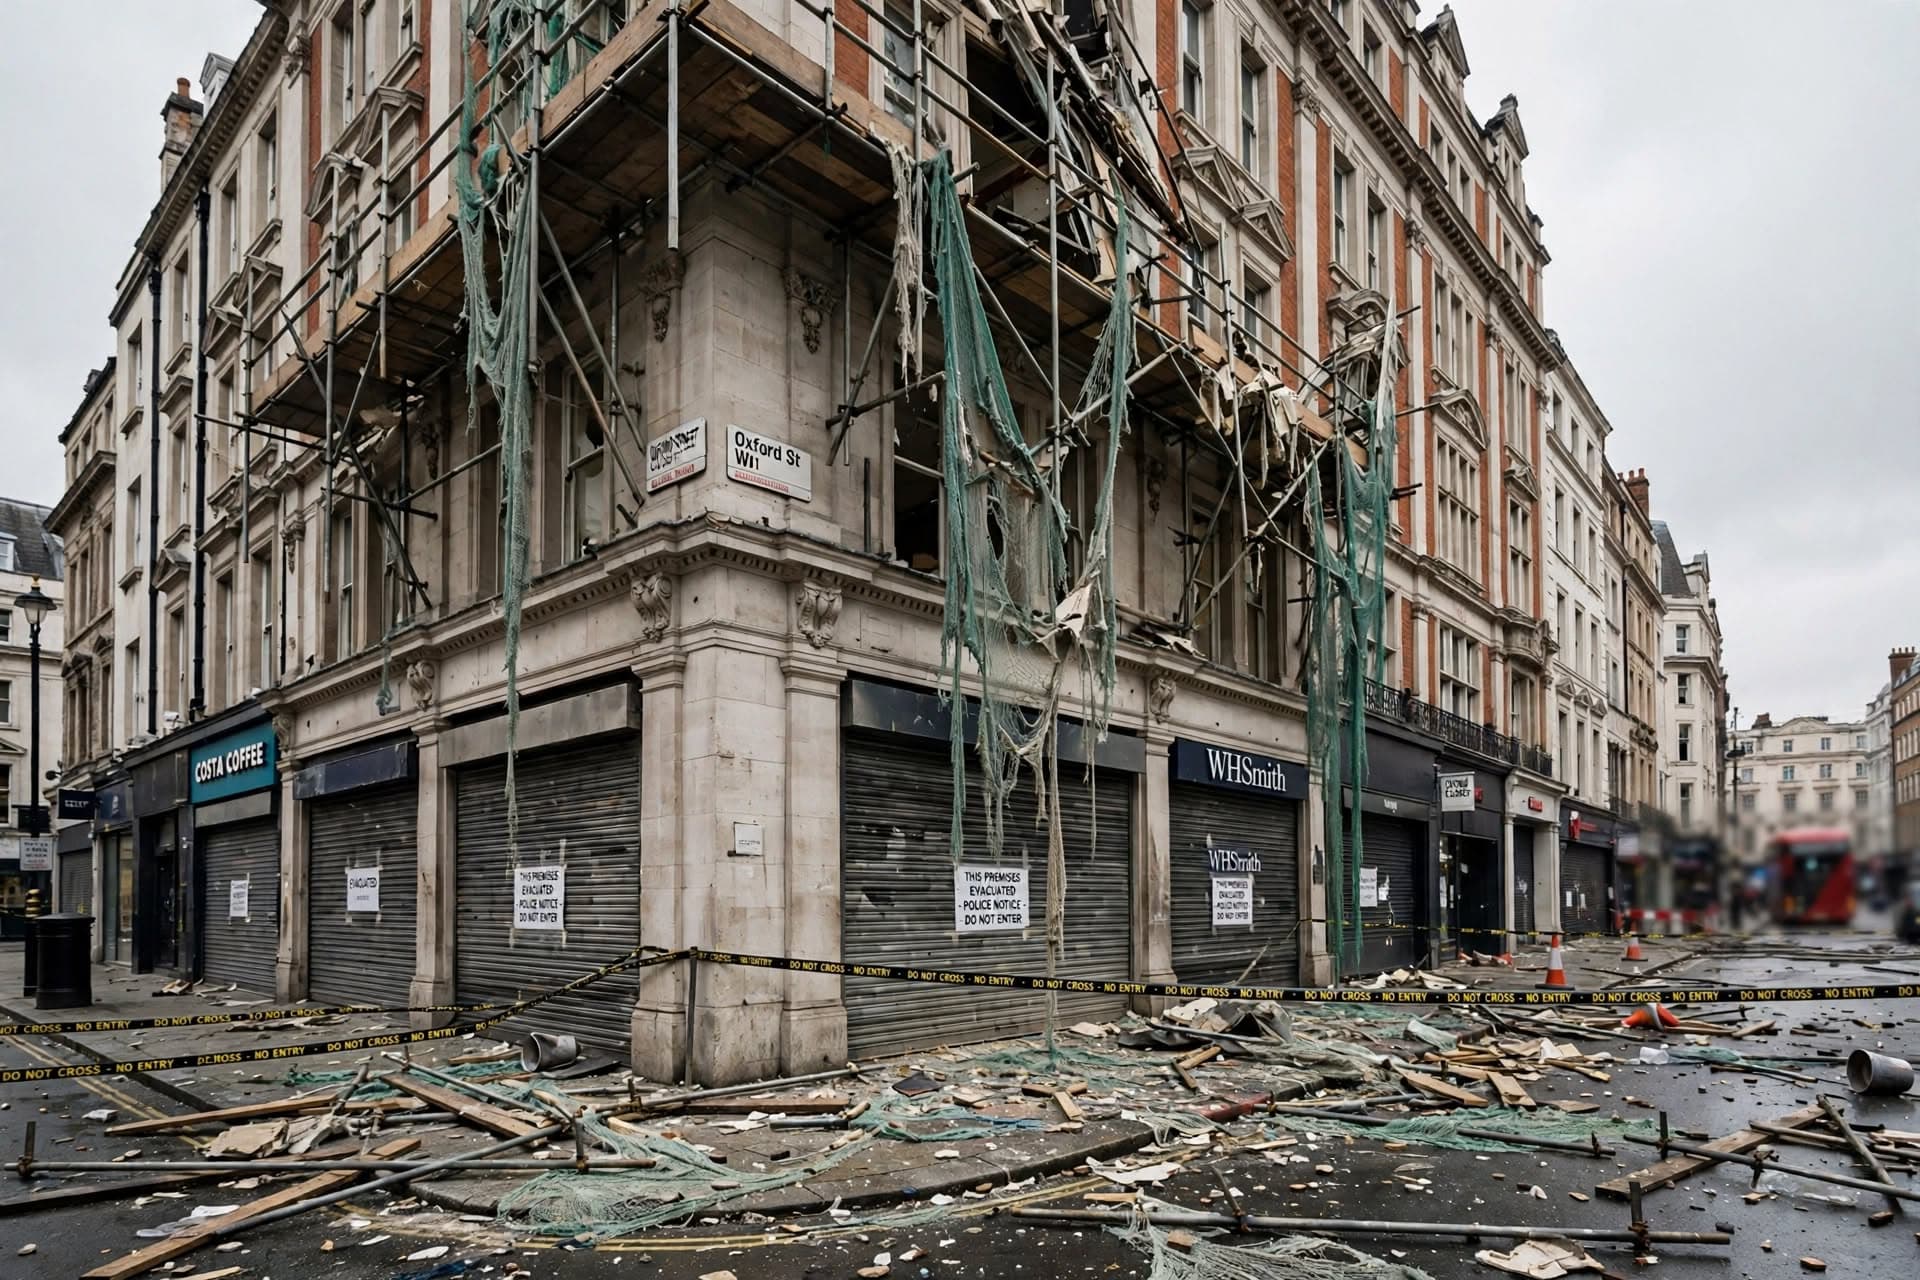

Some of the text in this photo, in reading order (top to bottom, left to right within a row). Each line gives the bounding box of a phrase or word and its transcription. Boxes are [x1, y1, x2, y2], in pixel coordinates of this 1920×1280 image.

[735, 431, 801, 468] Oxford St
[195, 742, 264, 783] COSTA COFFEE
[1207, 747, 1287, 792] WHSmith
[965, 872, 1020, 882] THIS PREMISES
[970, 886, 1015, 896] EVACUATED
[964, 900, 1020, 910] POLICE NOTICE
[965, 914, 1021, 925] DO NOT ENTER
[789, 960, 801, 969] DO
[802, 962, 818, 971] NOT
[820, 961, 845, 973] CROSS
[853, 966, 865, 975] NO
[866, 967, 891, 977] ENTRY
[907, 970, 919, 979] DO
[920, 971, 937, 981] NOT
[939, 973, 965, 983] CROSS
[974, 975, 986, 984] NO
[988, 975, 1015, 985] ENTRY
[1032, 979, 1044, 988] DO
[1046, 980, 1063, 989] NOT
[1068, 981, 1094, 991] CROSS
[1104, 983, 1117, 992] NO
[1119, 981, 1147, 993] ENTRY
[1165, 985, 1178, 995] DO
[1180, 984, 1198, 996] NOT
[1200, 987, 1230, 997] CROSS
[1240, 989, 1253, 998] NO
[1256, 989, 1284, 999] ENTRY
[1304, 988, 1317, 1000] DO
[1319, 990, 1337, 1000] NOT
[1341, 990, 1372, 1001] CROSS
[1382, 990, 1395, 1002] NO
[1397, 990, 1428, 1002] ENTRY
[1447, 992, 1460, 1002] DO
[1463, 991, 1481, 1003] NOT
[1485, 992, 1515, 1003] CROSS
[1525, 991, 1539, 1003] NO
[1541, 991, 1571, 1003] ENTRY
[1592, 992, 1605, 1002] DO
[1608, 992, 1627, 1002] NOT
[1630, 992, 1662, 1001] CROSS
[1672, 991, 1686, 1002] NO
[1688, 991, 1719, 1001] ENTRY
[1740, 990, 1754, 1000] DO
[1757, 990, 1776, 1000] NOT
[1780, 989, 1813, 999] CROSS
[1824, 988, 1840, 998] NO
[1842, 987, 1875, 998] ENTRY
[1898, 986, 1913, 996] DO
[23, 1023, 62, 1033] CROSS
[76, 1021, 92, 1031] NO
[96, 1020, 131, 1030] ENTRY
[154, 1017, 168, 1027] DO
[172, 1016, 192, 1026] NOT
[197, 1014, 231, 1024] CROSS
[2, 1071, 21, 1081] DO
[25, 1069, 51, 1079] NOT
[57, 1065, 101, 1077] CROSS
[116, 1063, 133, 1072] NO
[137, 1059, 174, 1071] ENTRY
[254, 1049, 269, 1059] NO
[272, 1046, 305, 1058] ENTRY
[327, 1042, 341, 1052] DO
[344, 1039, 364, 1049] NOT
[367, 1035, 400, 1048] CROSS
[411, 1031, 425, 1042] NO
[427, 1028, 457, 1039] ENTRY
